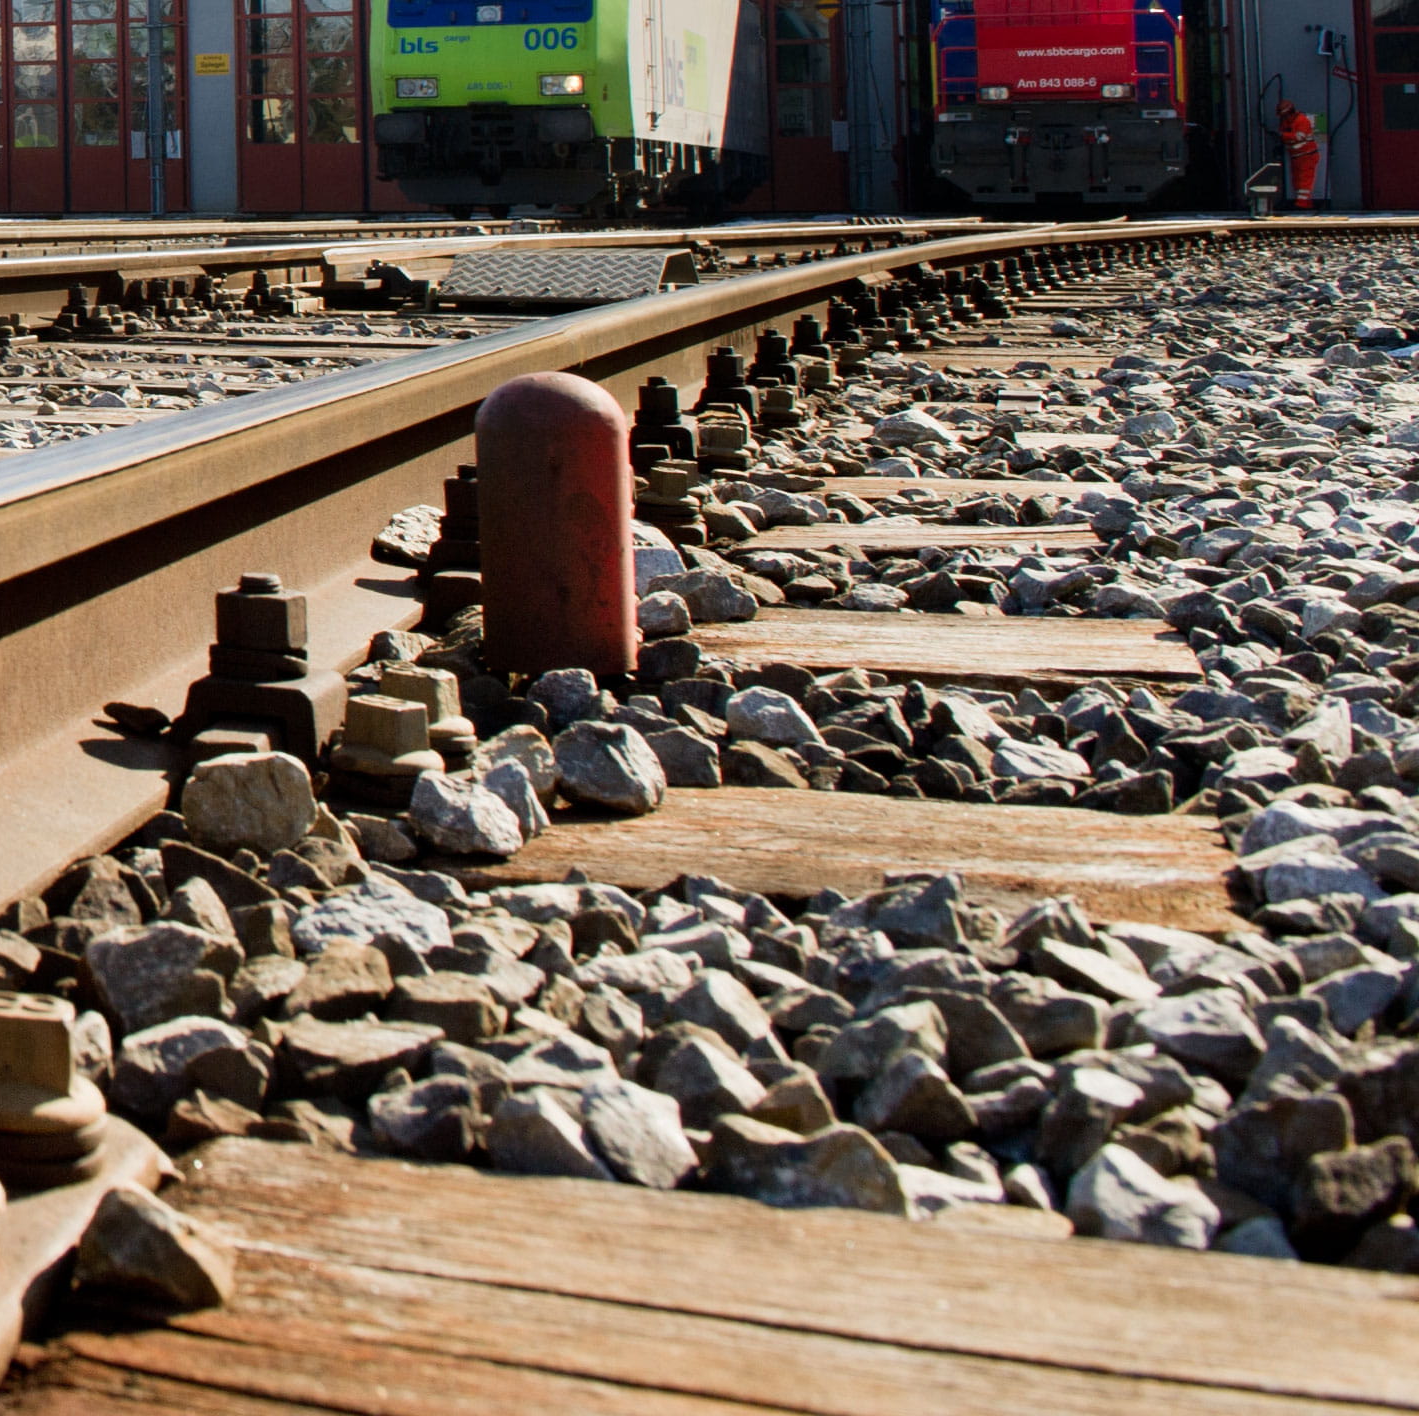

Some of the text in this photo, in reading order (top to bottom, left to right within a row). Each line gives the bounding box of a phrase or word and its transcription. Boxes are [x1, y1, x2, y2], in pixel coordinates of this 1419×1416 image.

[399, 37, 439, 55] bls
[524, 27, 578, 51] 006
[1017, 47, 1126, 58] www.sbbcargo.com
[1017, 78, 1036, 88] Am
[1039, 78, 1061, 88] 843
